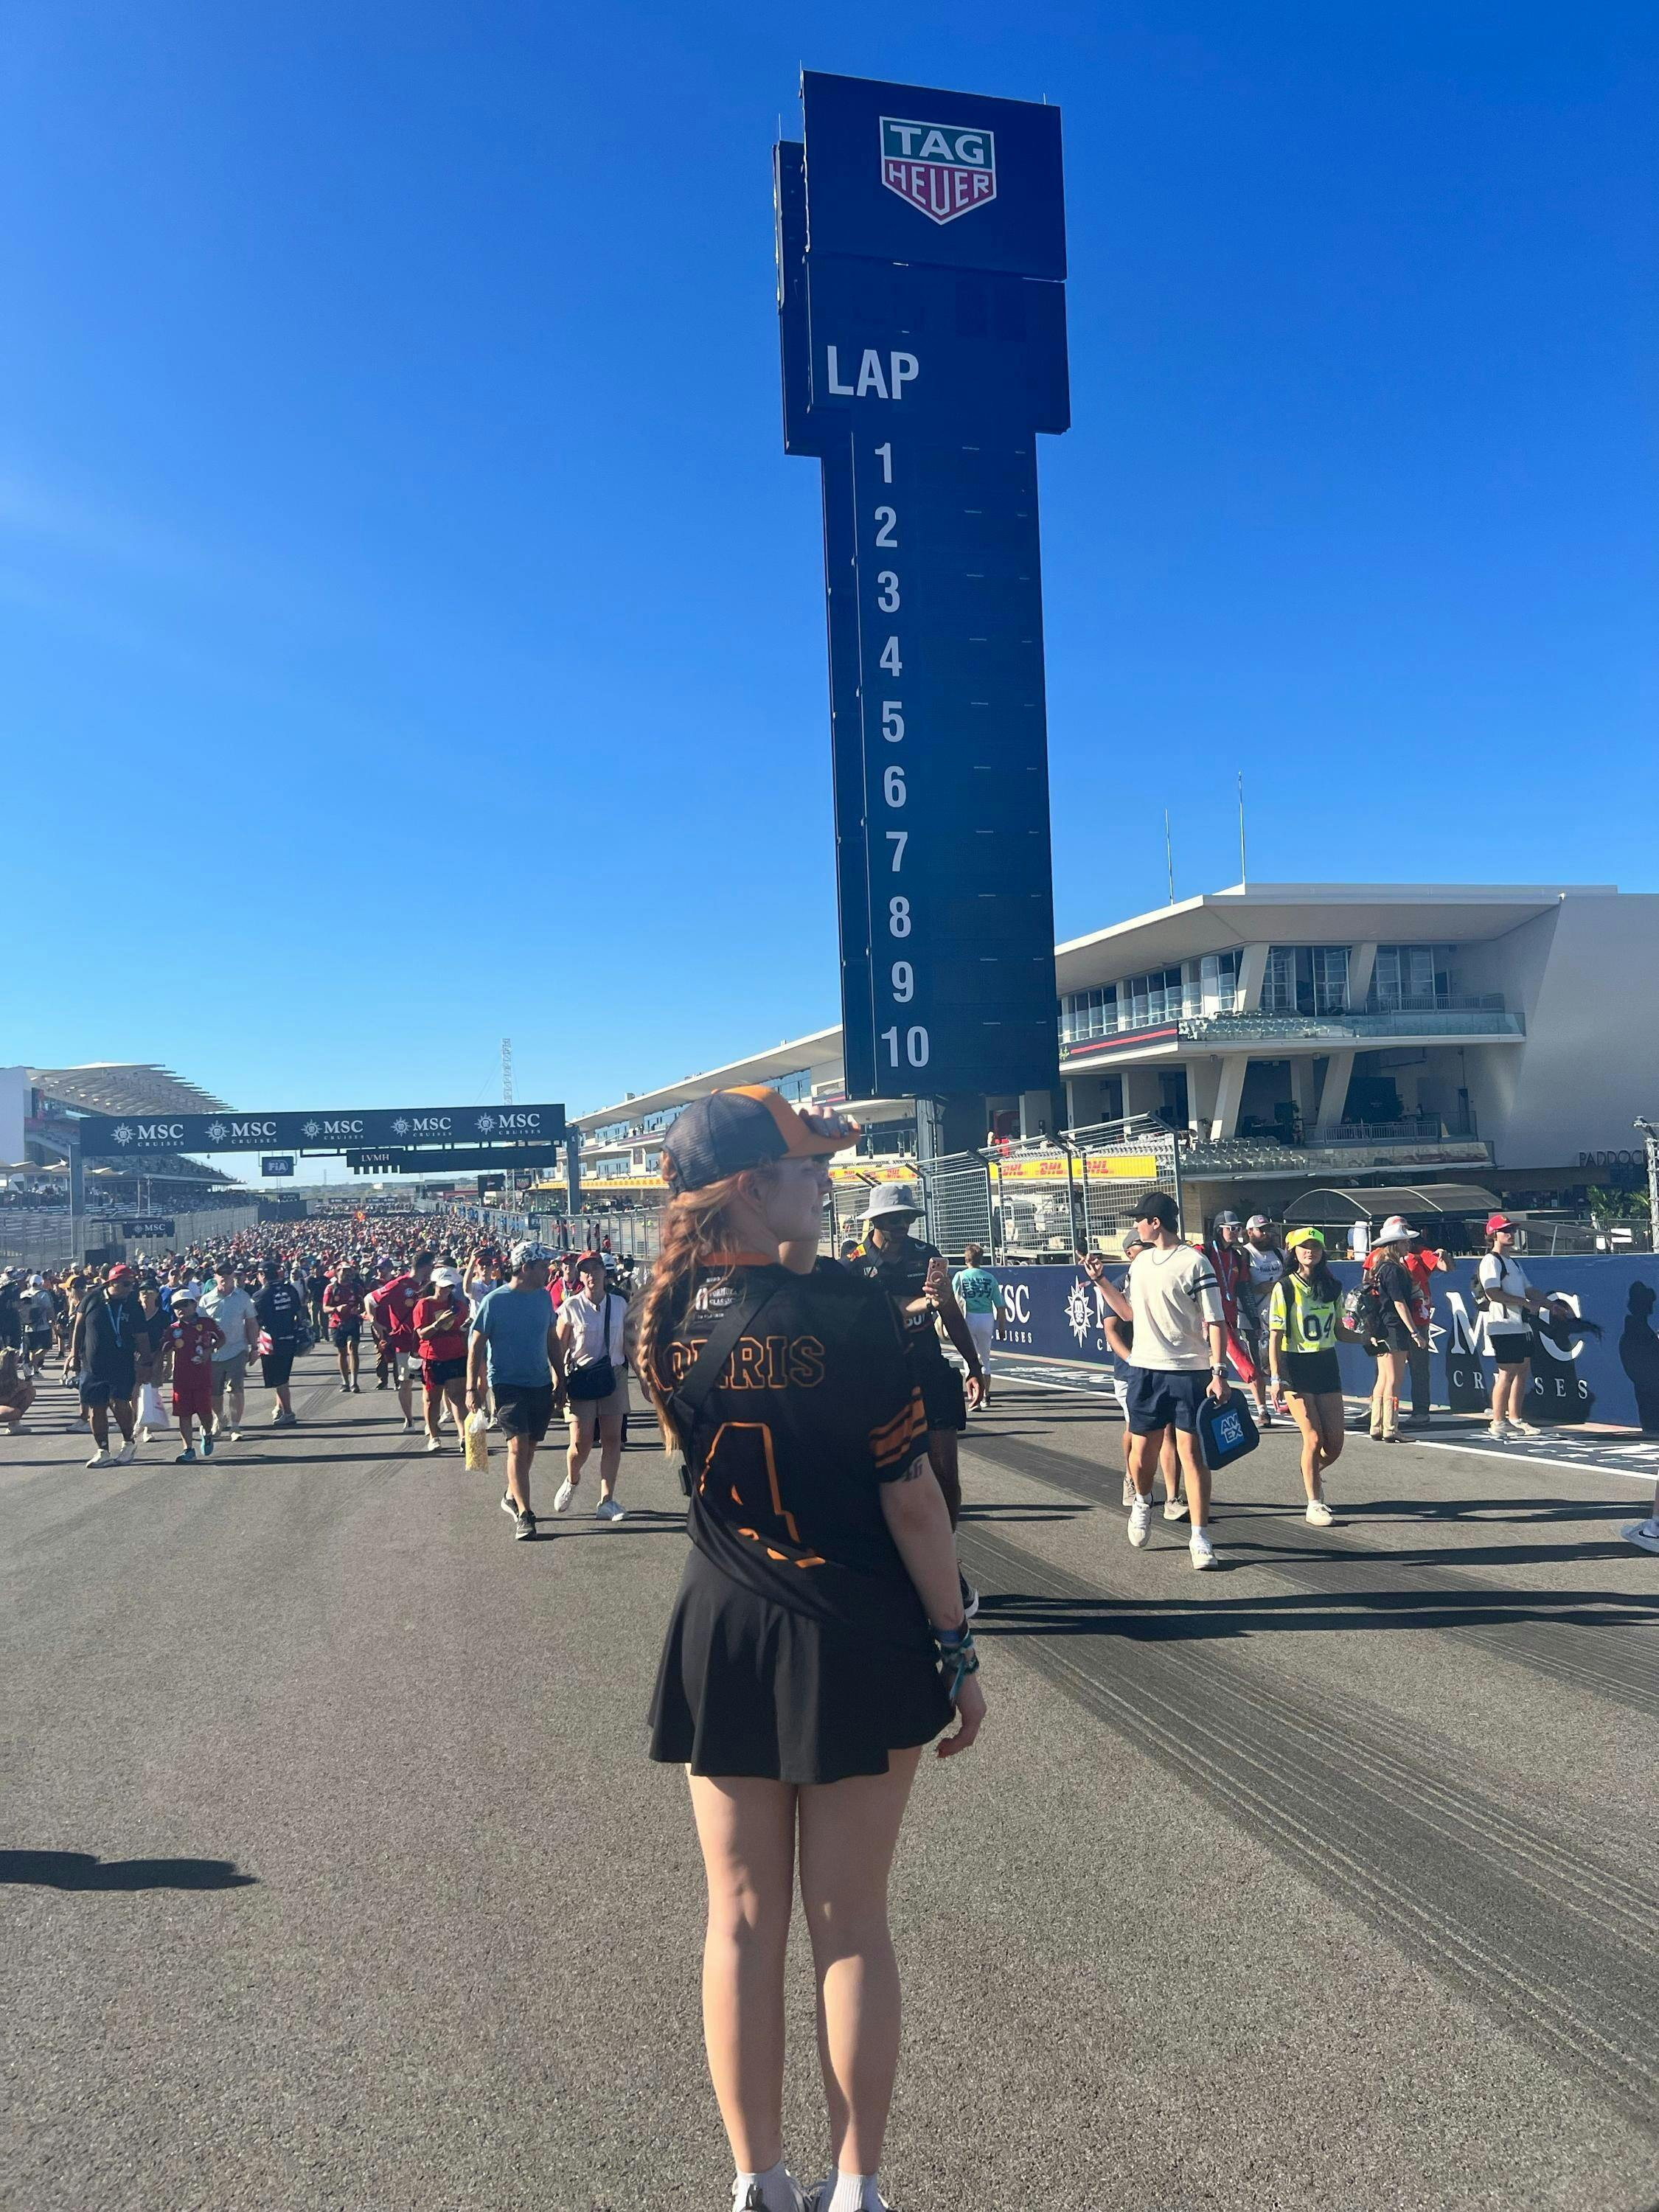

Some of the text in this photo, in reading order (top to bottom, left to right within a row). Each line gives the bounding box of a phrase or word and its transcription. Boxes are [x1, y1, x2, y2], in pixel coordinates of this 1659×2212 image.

[889, 125, 984, 164] TAG
[888, 163, 990, 212] HEUER
[827, 344, 919, 400] LAP
[874, 442, 892, 484] 1
[874, 506, 898, 548] 2
[877, 571, 900, 613] 3
[879, 636, 902, 677] 4
[882, 701, 905, 742] 5
[884, 765, 907, 808] 6
[886, 831, 908, 872] 7
[888, 896, 911, 938] 8
[891, 961, 914, 1003] 9
[881, 1026, 930, 1068] 10
[138, 1113, 540, 1140] MSC MSC MSC MSC MSC
[361, 1154, 390, 1162] LVMH
[1445, 1291, 1584, 1362] MC
[1453, 1369, 1589, 1399] CRSES
